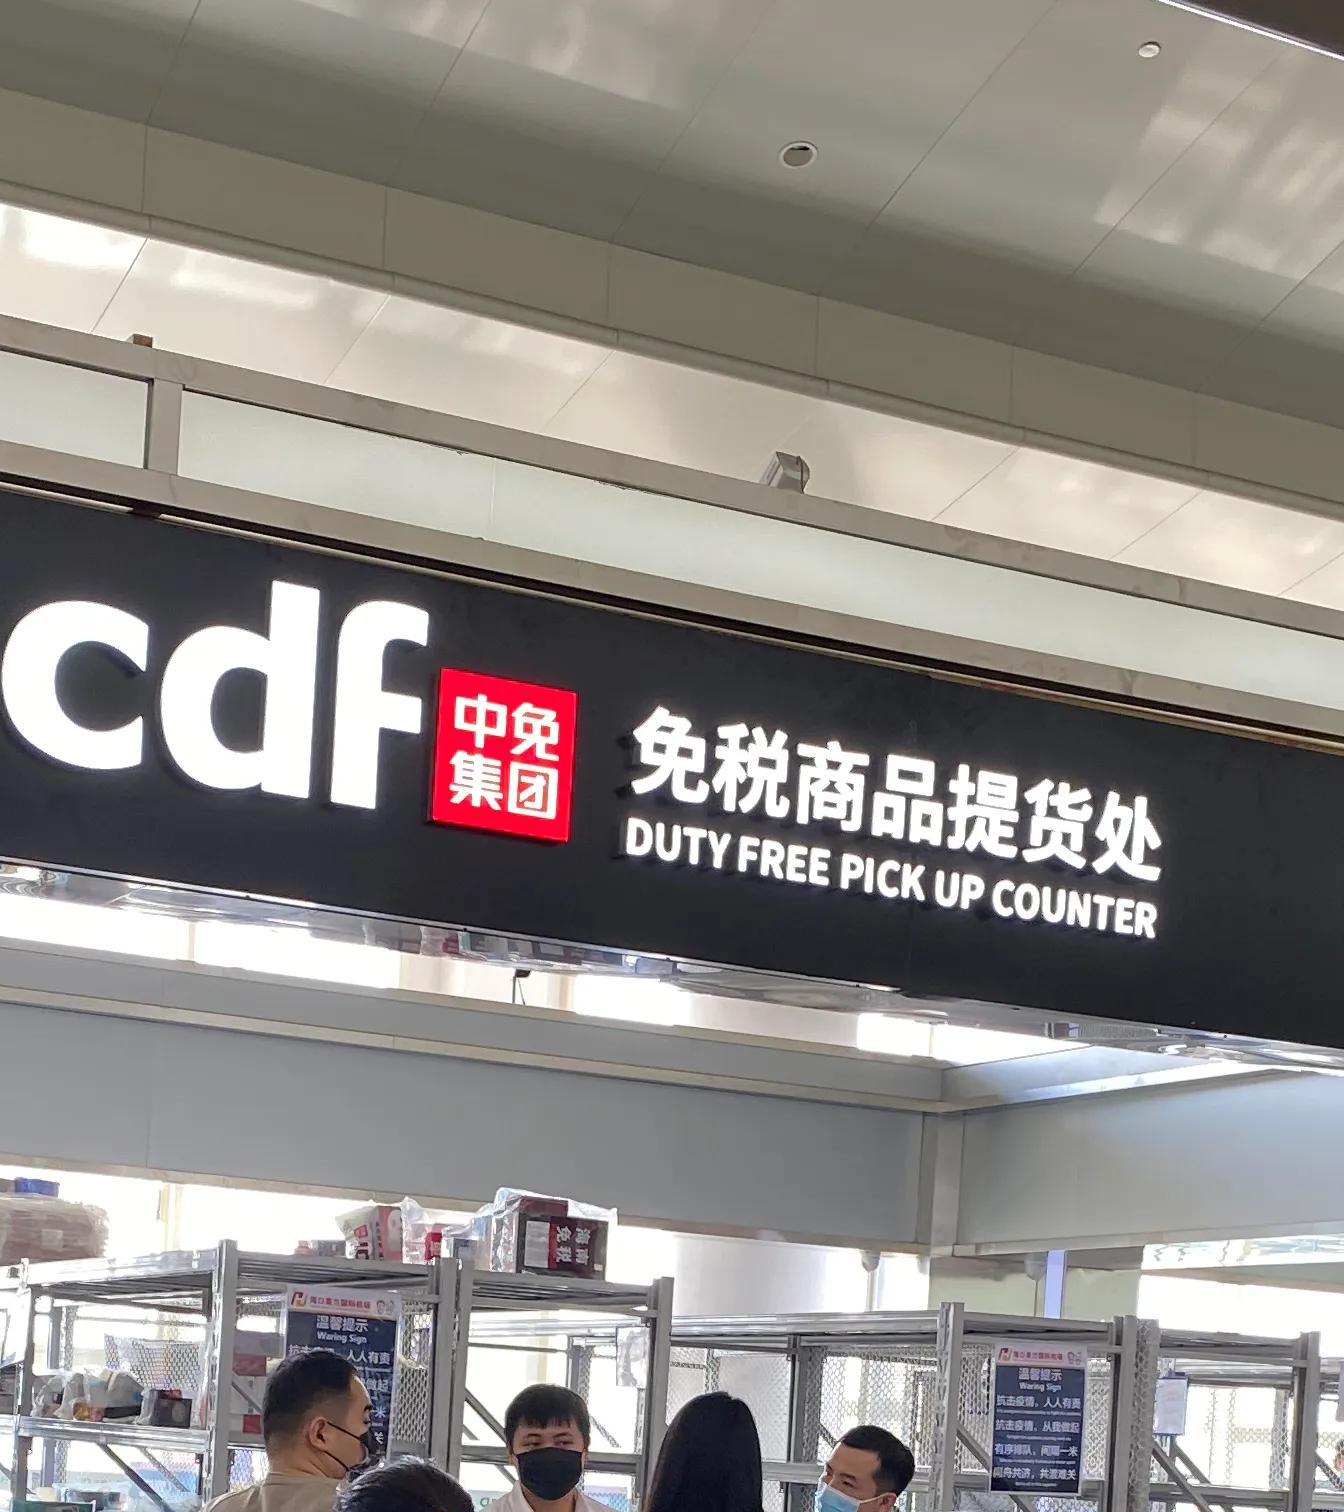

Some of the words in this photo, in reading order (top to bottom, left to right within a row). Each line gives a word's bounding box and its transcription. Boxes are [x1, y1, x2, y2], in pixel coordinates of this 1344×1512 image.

[1, 580, 430, 811] cdf
[453, 692, 561, 762] 中免
[447, 748, 560, 821] 集团
[630, 705, 1163, 883] 免税商品提货处
[625, 816, 733, 870] DUTY
[736, 834, 832, 887] FREE
[839, 852, 927, 902] PICK
[933, 869, 986, 911] UP
[991, 878, 1159, 940] COUNTER
